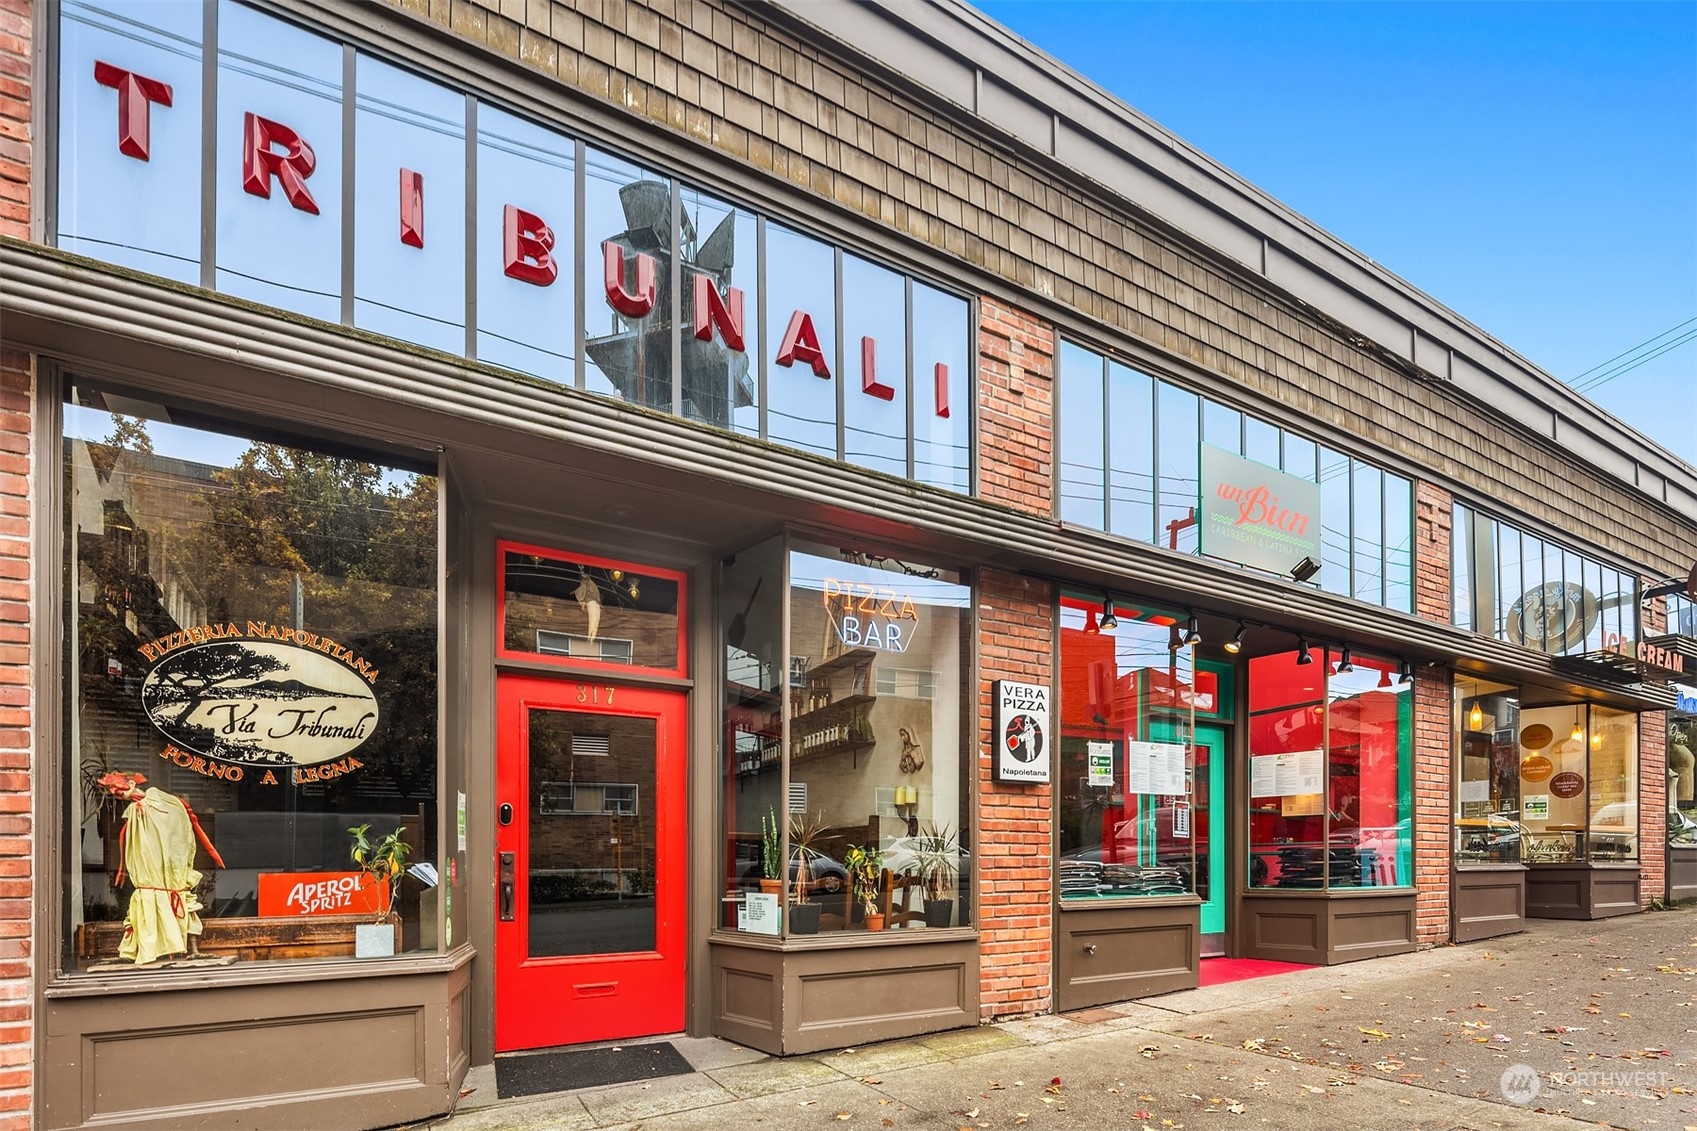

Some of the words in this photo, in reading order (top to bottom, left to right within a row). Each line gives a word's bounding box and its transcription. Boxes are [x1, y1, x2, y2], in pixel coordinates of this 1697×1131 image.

[94, 59, 951, 419] TRIBUNALI
[1216, 482, 1243, 504] un
[1234, 484, 1310, 536] Bien
[1210, 524, 1257, 546] CARIBBEAN
[1265, 540, 1293, 555] LATINA
[823, 577, 918, 621] PIZZA
[843, 615, 903, 652] BAR
[1602, 630, 1628, 656] ICE
[1637, 641, 1684, 673] CREAM
[138, 622, 241, 662] PIZZERIA
[247, 621, 379, 684] NAPOLETANA
[576, 683, 615, 705] 317
[1003, 685, 1046, 700] VERA
[1003, 698, 1046, 712] PIZZA
[207, 703, 259, 735] Via
[268, 705, 376, 740] Tribunali
[1669, 723, 1688, 743] Open
[159, 743, 244, 782] FORNO
[260, 769, 279, 785] A
[293, 756, 364, 784] LEGNA
[1002, 767, 1047, 777] Napoletana
[286, 875, 362, 907] APEROL
